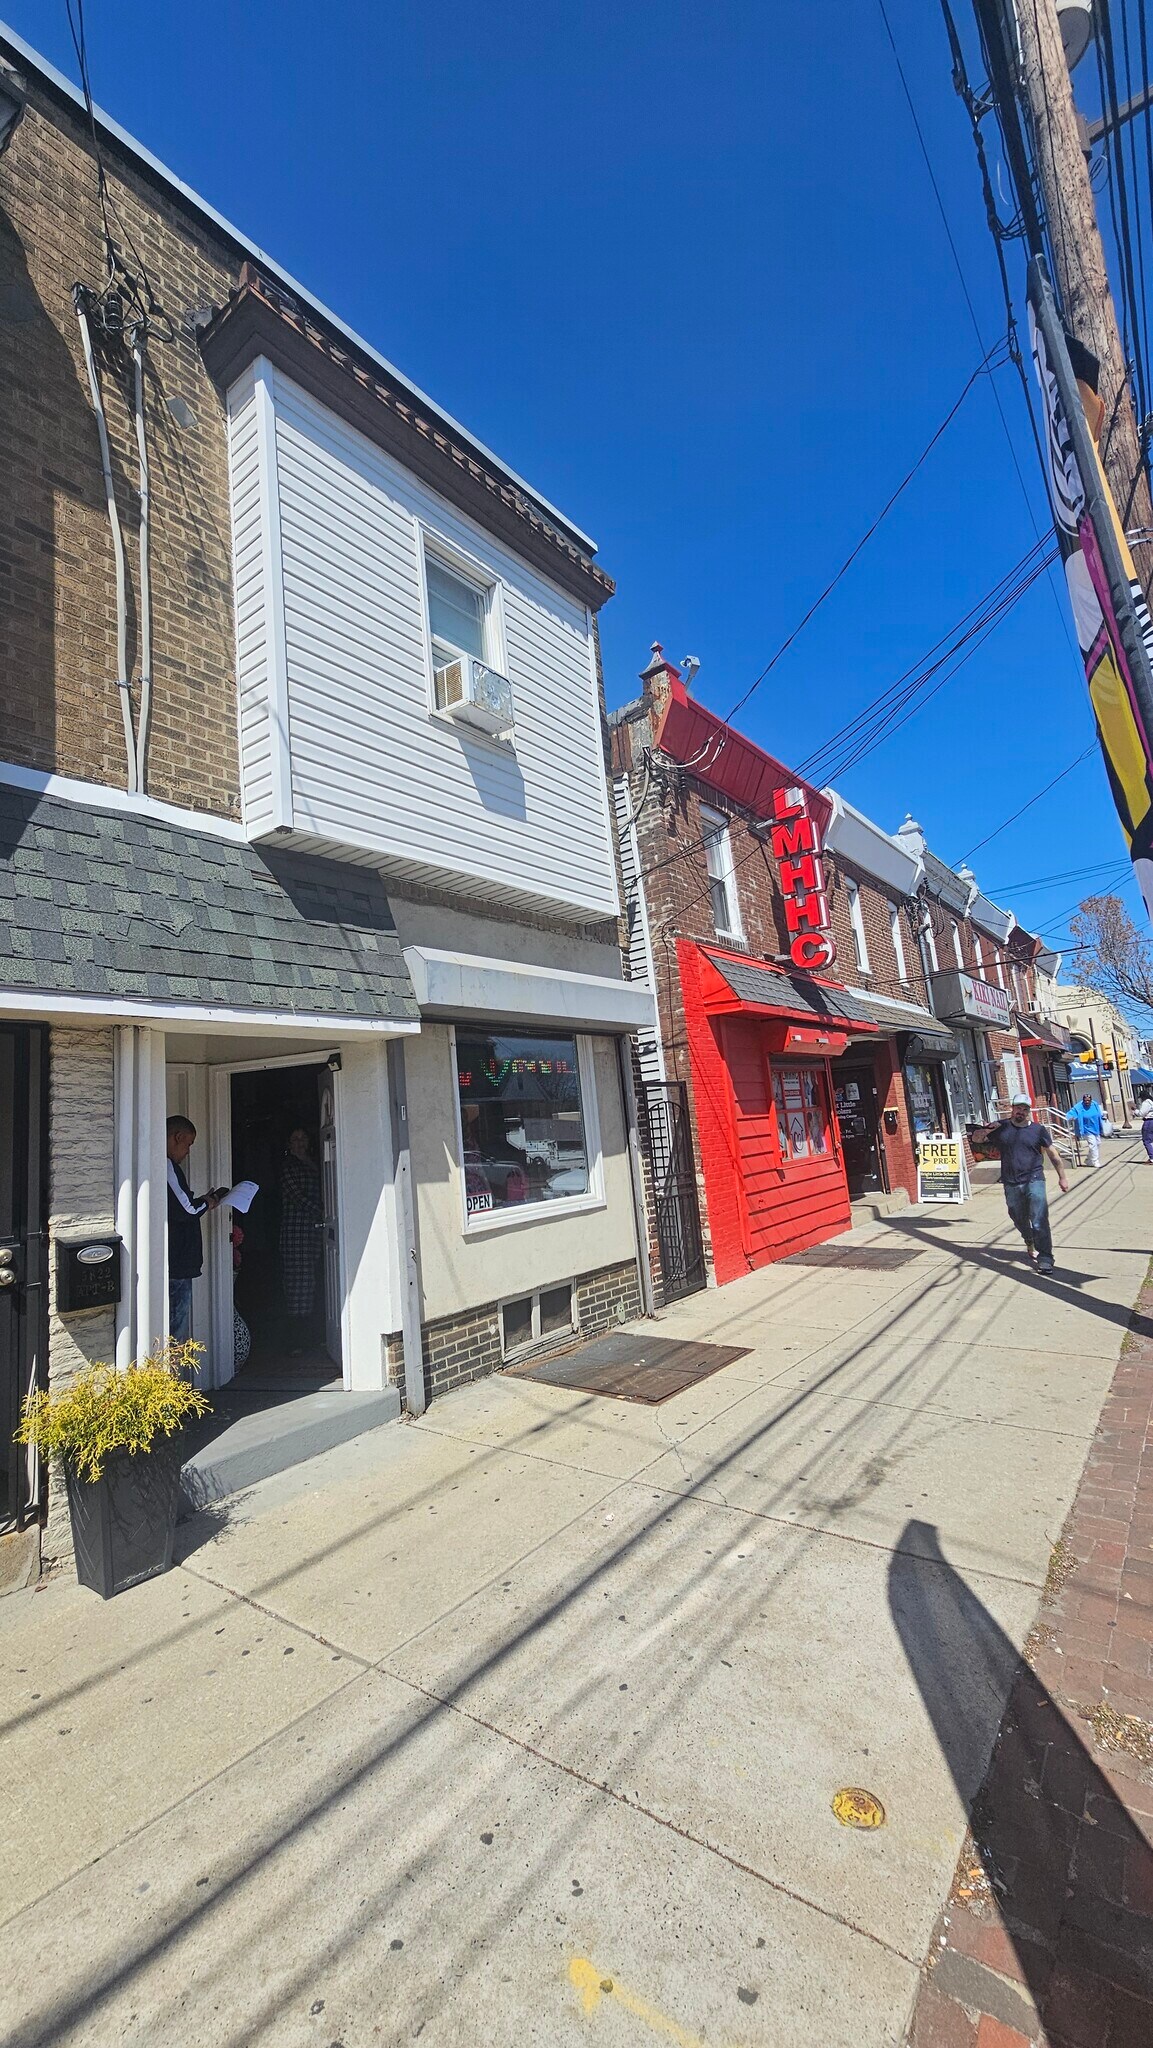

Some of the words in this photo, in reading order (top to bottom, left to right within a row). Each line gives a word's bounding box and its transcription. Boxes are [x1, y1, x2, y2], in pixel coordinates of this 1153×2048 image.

[771, 788, 834, 969] LMHHC
[972, 980, 991, 1005] KIKI
[922, 1144, 957, 1157] FREE
[933, 1157, 957, 1165] PRE-K
[466, 1194, 491, 1211] OPEN
[81, 1267, 112, 1282] 5822
